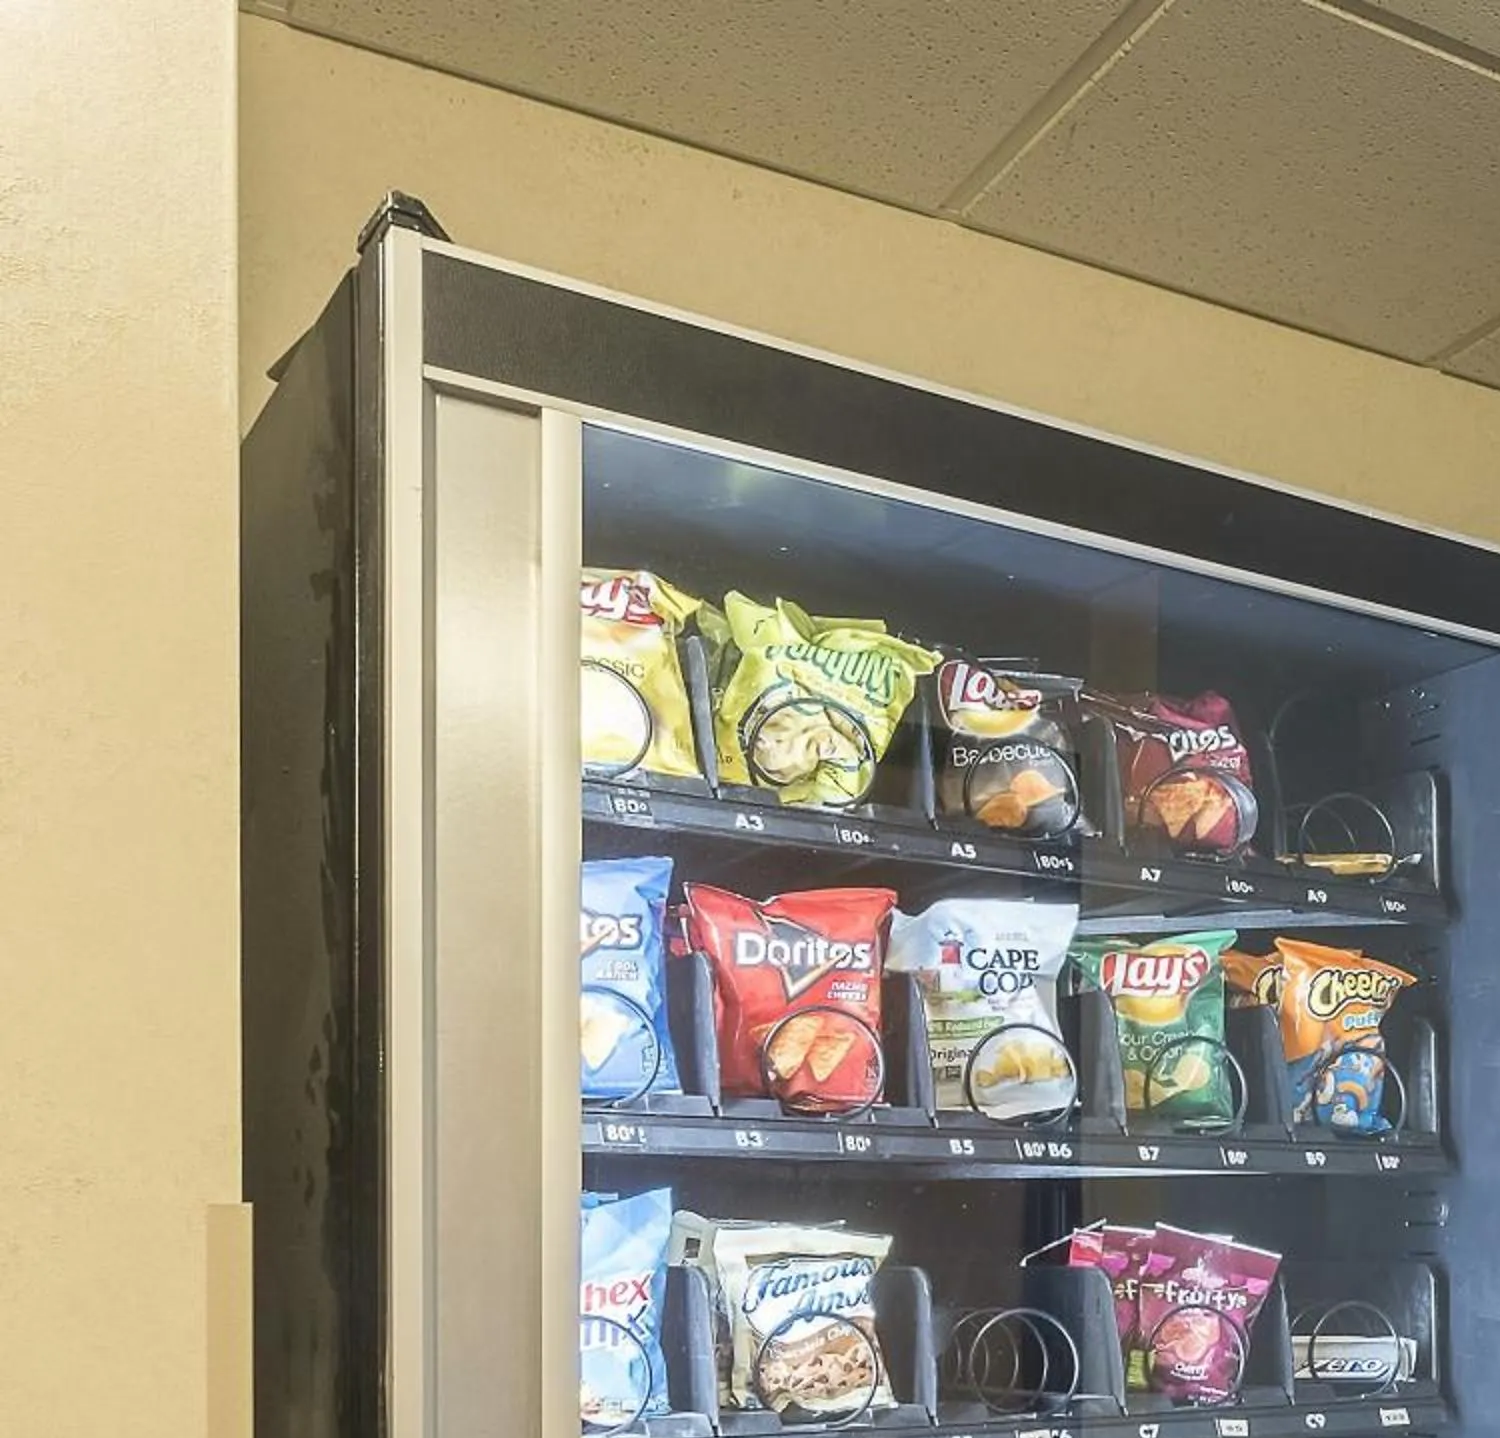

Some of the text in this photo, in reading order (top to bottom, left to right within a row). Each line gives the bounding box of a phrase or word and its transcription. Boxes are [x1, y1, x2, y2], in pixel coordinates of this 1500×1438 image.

[952, 744, 1052, 767] Babecue
[735, 813, 764, 832] A3
[951, 842, 977, 859] A5
[1141, 868, 1161, 882] A7
[1307, 888, 1326, 904] A9
[735, 930, 873, 970] Doritos
[966, 947, 1041, 972] CAPE
[978, 969, 1035, 996] COD
[1120, 1032, 1150, 1047] our
[736, 1131, 764, 1148] B3
[949, 1139, 975, 1156] B5
[1048, 1143, 1072, 1158] B6
[1138, 1146, 1159, 1161] B7
[1305, 1151, 1326, 1167] B9
[742, 1258, 874, 1314] Famous
[1306, 1413, 1326, 1429] C9
